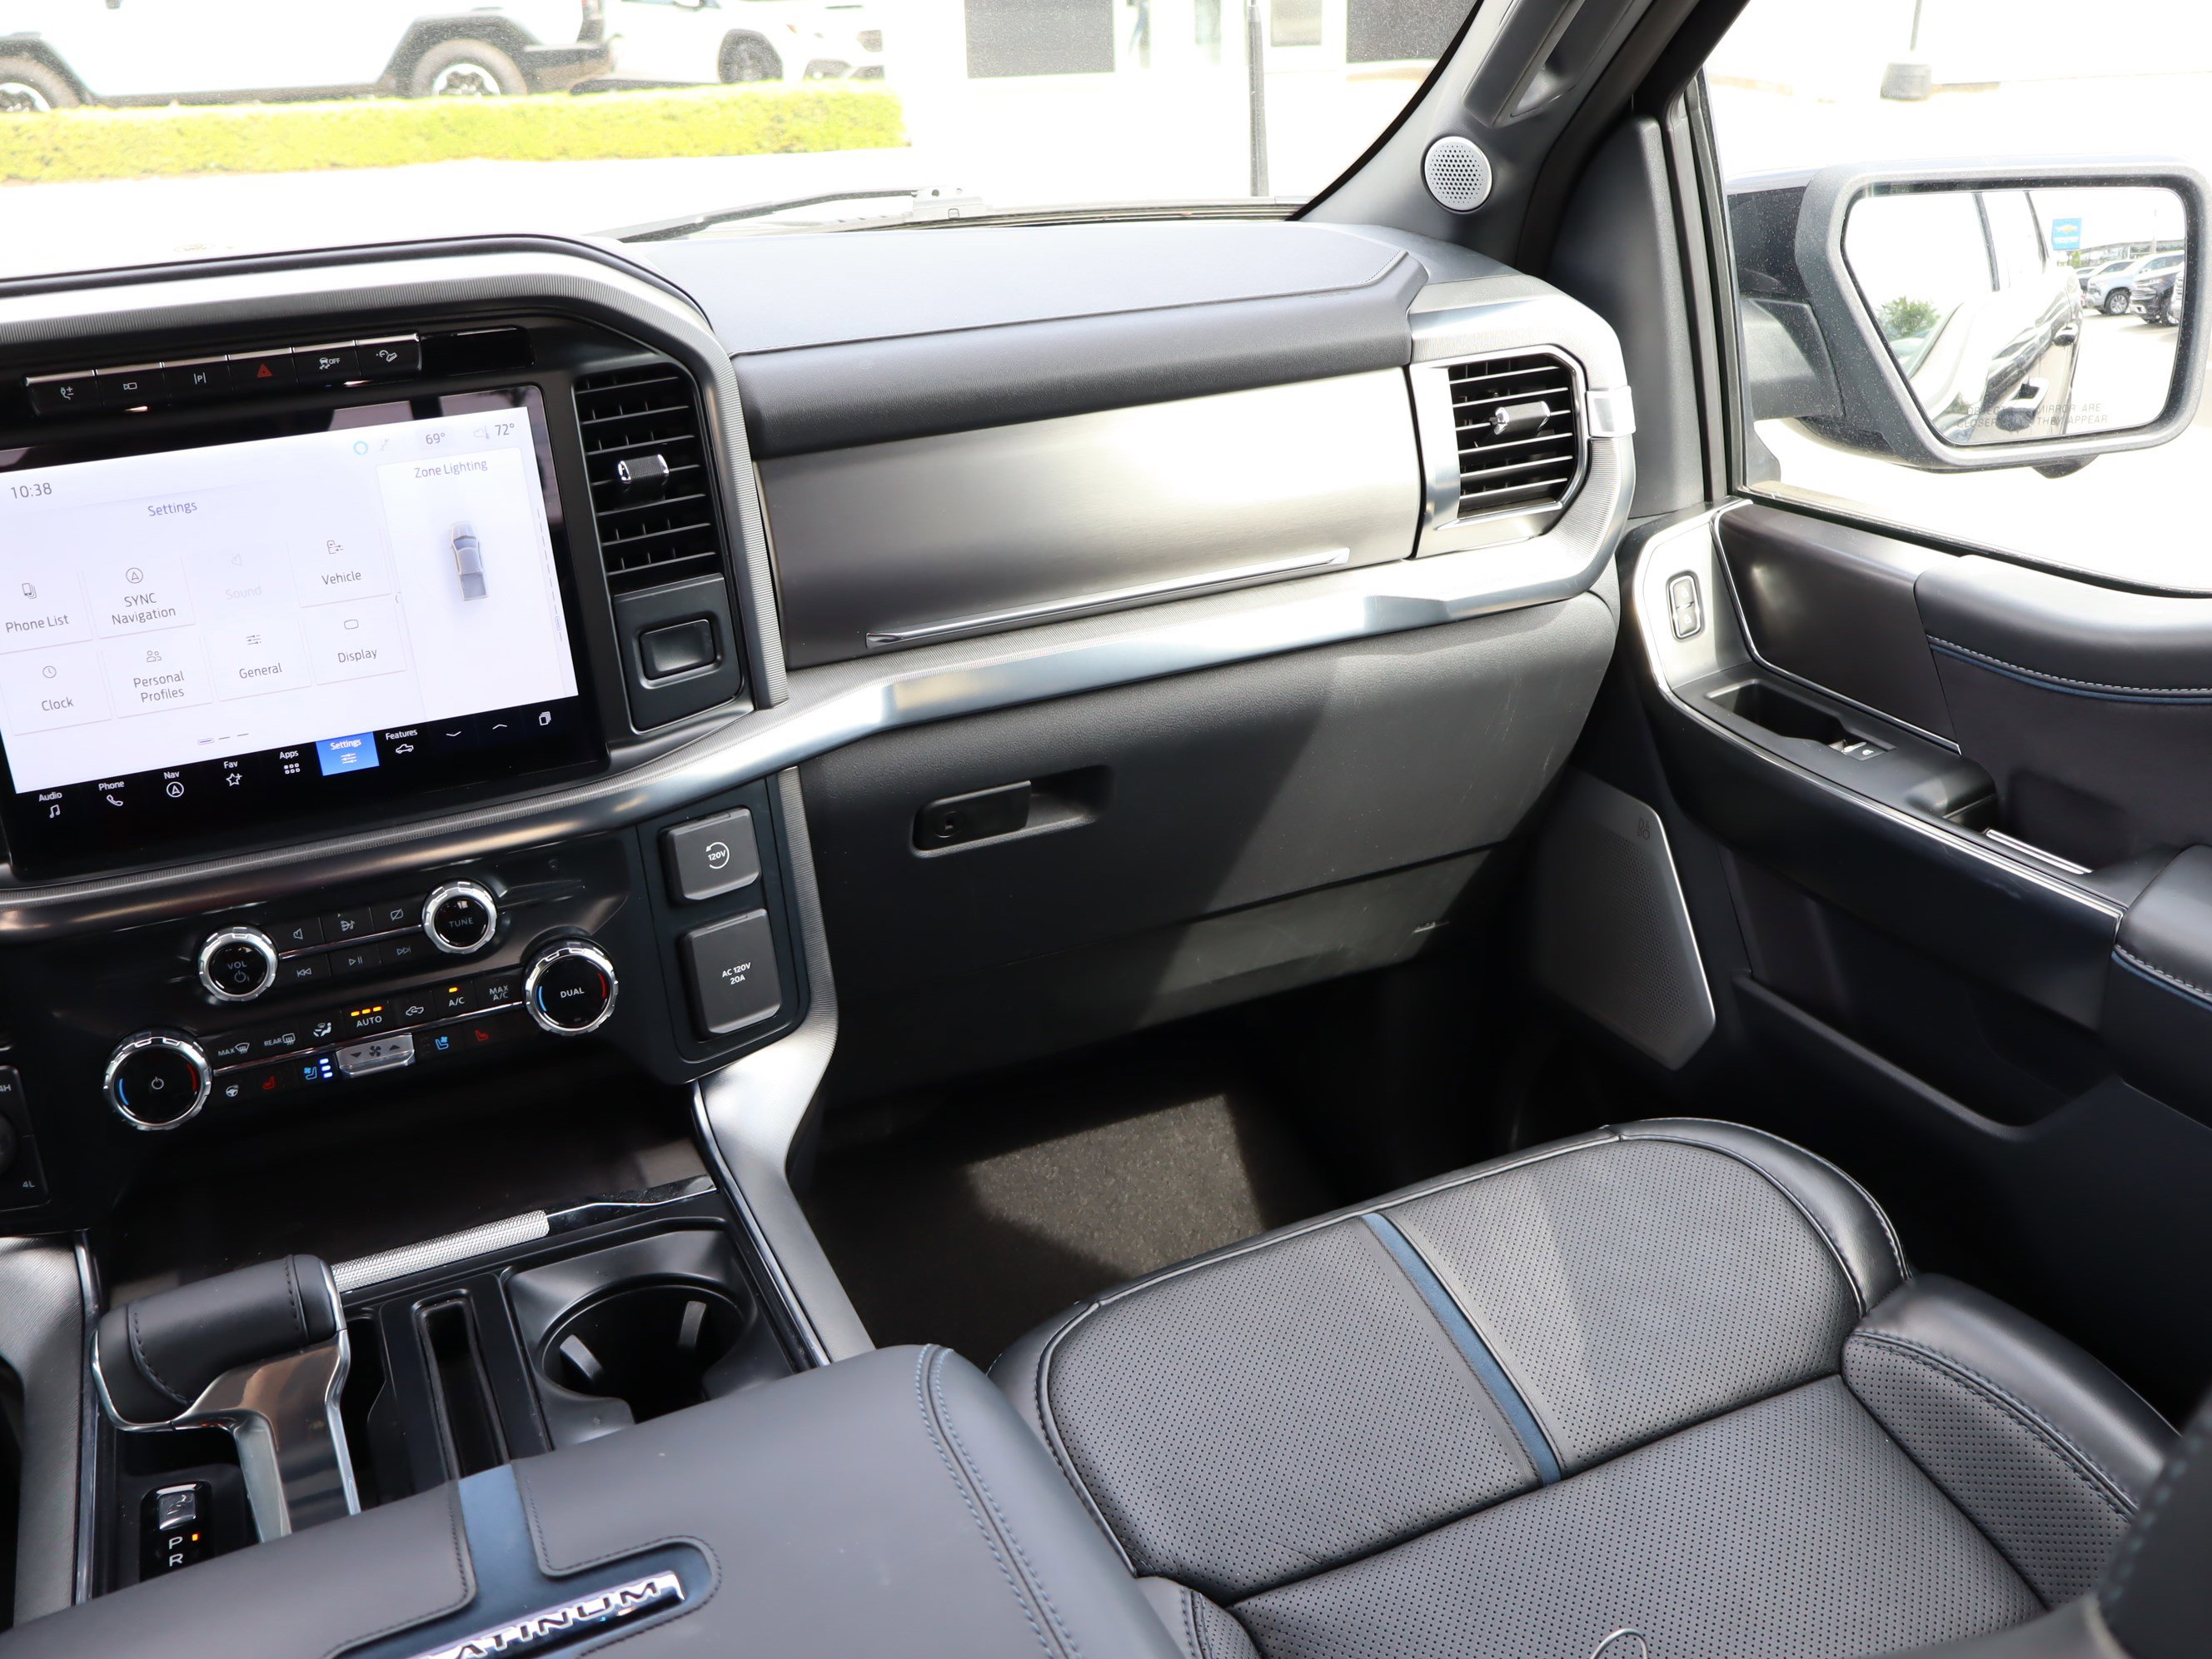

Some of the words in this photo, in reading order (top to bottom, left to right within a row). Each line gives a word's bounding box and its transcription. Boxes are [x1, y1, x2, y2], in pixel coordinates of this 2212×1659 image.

[1967, 406, 2012, 416] OBECT
[2038, 404, 2075, 414] MIRROR
[2081, 403, 2101, 413] ARE
[2037, 416, 2062, 426] THEY
[2069, 414, 2109, 425] APPEAR
[495, 422, 515, 436] 72°
[426, 431, 446, 445] 69°
[414, 465, 442, 479] Zone
[443, 460, 488, 476] Lighting
[11, 482, 52, 499] 10:38
[147, 501, 198, 517] Settings
[321, 570, 361, 585] Vehicle
[225, 585, 262, 600] Sound
[124, 592, 157, 607] SYNC
[112, 605, 177, 625] Navigation
[6, 618, 45, 633] Phone
[47, 614, 70, 627] List
[337, 648, 377, 663] Display
[239, 663, 282, 679] General
[133, 670, 185, 688] Personal
[140, 686, 185, 703] Profiles
[41, 696, 74, 711] Clock
[386, 730, 417, 740] Features
[330, 738, 361, 750] Settings
[279, 750, 299, 761] Apps
[223, 760, 239, 770] Fav
[163, 770, 180, 780] Nav
[98, 780, 125, 791] Phone
[38, 790, 62, 802] Audio
[708, 849, 726, 861] 120V
[449, 917, 474, 928] TUNE
[227, 960, 247, 970] VOL
[722, 968, 733, 978] AC
[733, 962, 751, 974] 120V
[730, 973, 745, 985] 20A
[489, 984, 509, 995] MAX
[493, 991, 508, 1001] A/C
[560, 986, 585, 999] DUAL
[448, 996, 465, 1007] A/C
[356, 1015, 382, 1028] AUTO
[264, 1038, 281, 1047] REAR
[217, 1048, 236, 1057] MAX
[22, 1179, 36, 1188] 4L
[169, 1536, 183, 1550] P
[169, 1553, 183, 1567] R
[431, 1580, 661, 1659] ATINUM
